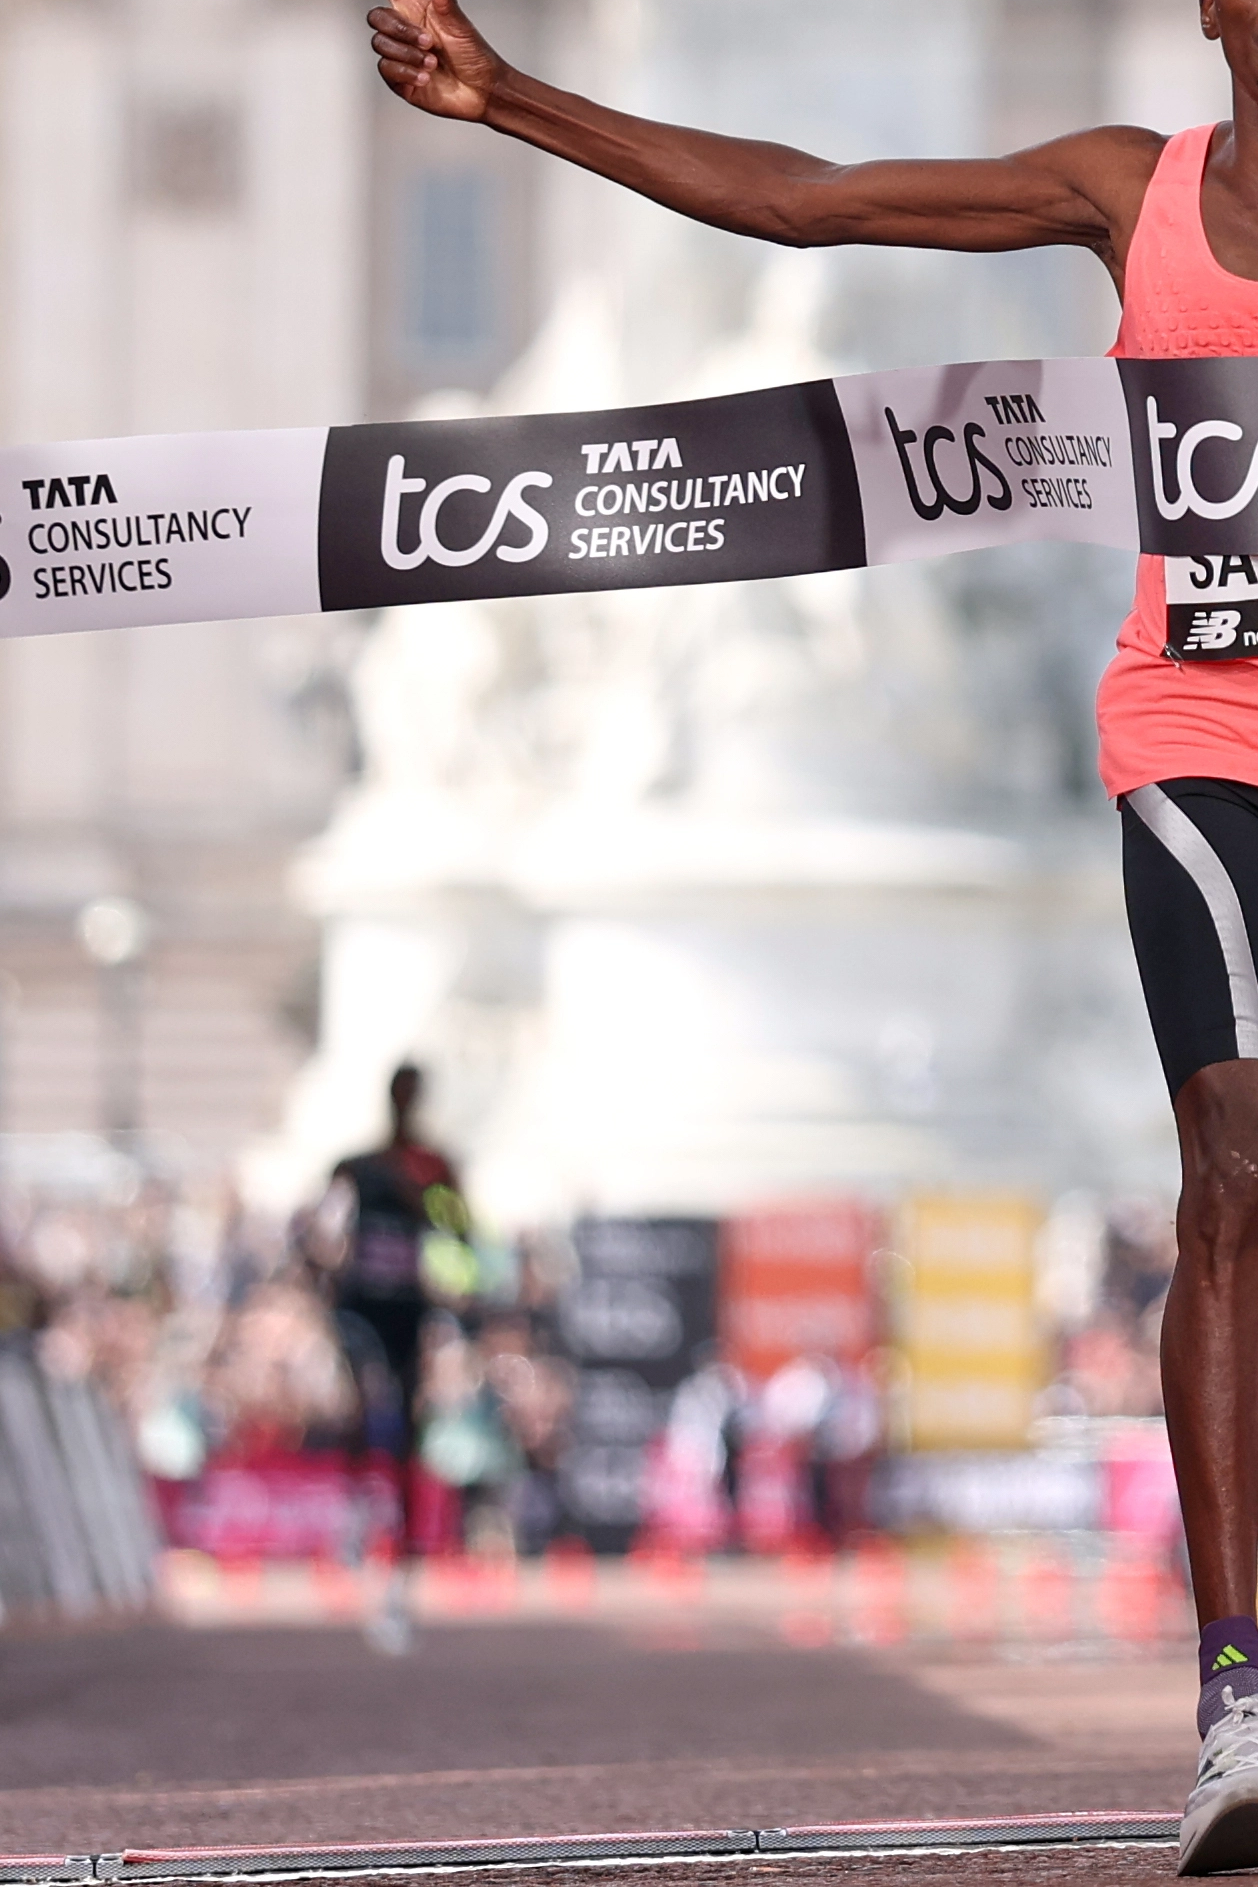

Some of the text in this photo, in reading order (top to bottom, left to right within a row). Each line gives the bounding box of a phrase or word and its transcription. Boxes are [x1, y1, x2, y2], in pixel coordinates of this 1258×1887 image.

[983, 393, 1046, 425] TATA
[580, 437, 683, 475] TATA
[884, 406, 1013, 521] tcs
[1004, 435, 1113, 468] CONSULTANCY
[21, 473, 118, 511] TATA
[574, 463, 806, 518] CONSULTANCY
[1021, 478, 1092, 510] SERVICES
[27, 506, 252, 555] CONSULTANCY
[381, 454, 553, 570] tcs
[567, 519, 725, 560] SERVICES
[33, 557, 172, 600] SERVICES
